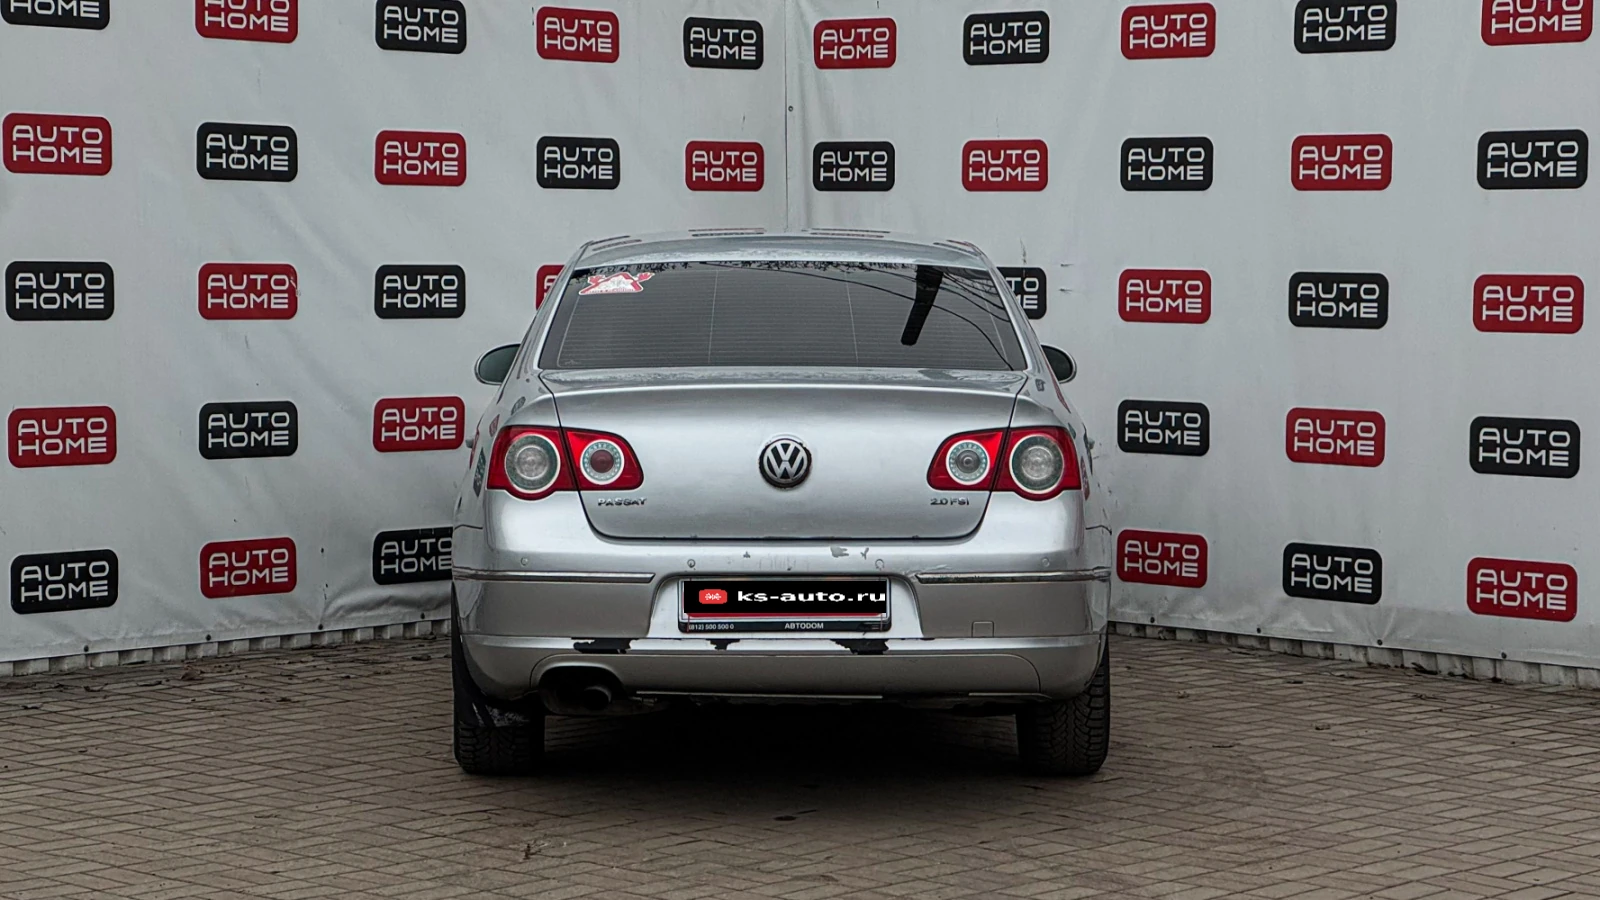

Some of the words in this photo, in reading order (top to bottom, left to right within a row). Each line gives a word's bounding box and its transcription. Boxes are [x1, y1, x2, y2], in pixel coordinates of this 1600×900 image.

[11, 0, 99, 18] HOME
[384, 6, 458, 25] AUTO
[1304, 5, 1387, 23] AUTO
[205, 11, 288, 32] HOME
[545, 17, 612, 35] AUTO
[971, 22, 1041, 37] AUTO
[1130, 14, 1207, 31] AUTO
[1492, 14, 1581, 34] HOME
[384, 24, 458, 43] HOME
[691, 27, 756, 43] AUTO
[821, 28, 889, 43] AUTO
[1130, 32, 1206, 49] HOME
[1303, 24, 1386, 42] HOME
[545, 35, 612, 52] HOME
[691, 44, 755, 59] HOME
[820, 44, 888, 59] HOME
[971, 39, 1040, 55] HOME
[13, 125, 102, 144] AUTO
[207, 134, 289, 152] AUTO
[13, 145, 101, 163] HOME
[384, 141, 458, 158] AUTO
[545, 147, 613, 162] AUTO
[693, 151, 757, 165] AUTO
[821, 151, 887, 165] AUTO
[970, 150, 1040, 164] AUTO
[1129, 148, 1204, 162] AUTO
[1300, 145, 1383, 161] AUTO
[1488, 141, 1578, 158] AUTO
[207, 153, 288, 170] HOME
[384, 159, 458, 175] HOME
[1487, 161, 1576, 177] HOME
[544, 164, 612, 179] HOME
[693, 167, 756, 181] HOME
[820, 168, 886, 181] HOME
[969, 167, 1039, 181] HOME
[1128, 166, 1203, 180] HOME
[1300, 164, 1381, 179] HOME
[16, 273, 105, 289] AUTO
[208, 275, 289, 290] AUTO
[384, 275, 458, 290] AUTO
[1127, 280, 1203, 295] AUTO
[1298, 283, 1379, 299] AUTO
[1483, 286, 1574, 302] AUTO
[16, 293, 104, 308] HOME
[208, 293, 288, 308] HOME
[383, 293, 457, 308] HOME
[1127, 297, 1201, 313] HOME
[1297, 301, 1377, 318] HOME
[1483, 305, 1572, 322] HOME
[208, 412, 289, 429] AUTO
[382, 407, 457, 423] AUTO
[1126, 410, 1201, 427] AUTO
[18, 418, 107, 436] AUTO
[382, 425, 456, 441] HOME
[1295, 419, 1376, 437] AUTO
[208, 431, 288, 448] HOME
[1125, 428, 1200, 445] HOME
[1480, 428, 1570, 447] AUTO
[18, 437, 106, 456] HOME
[1294, 437, 1374, 455] HOME
[1479, 447, 1568, 466] HOME
[597, 497, 647, 507] PASSAT
[381, 537, 452, 557] AUTO
[1125, 540, 1199, 559] AUTO
[209, 549, 288, 568] AUTO
[381, 555, 452, 574] HOME
[1292, 554, 1373, 574] AUTO
[21, 561, 109, 582] AUTO
[1125, 558, 1198, 577] HOME
[209, 567, 288, 587] HOME
[1291, 572, 1372, 593] HOME
[1477, 569, 1567, 590] AUTO
[21, 580, 108, 602] HOME
[1477, 588, 1566, 610] HOME
